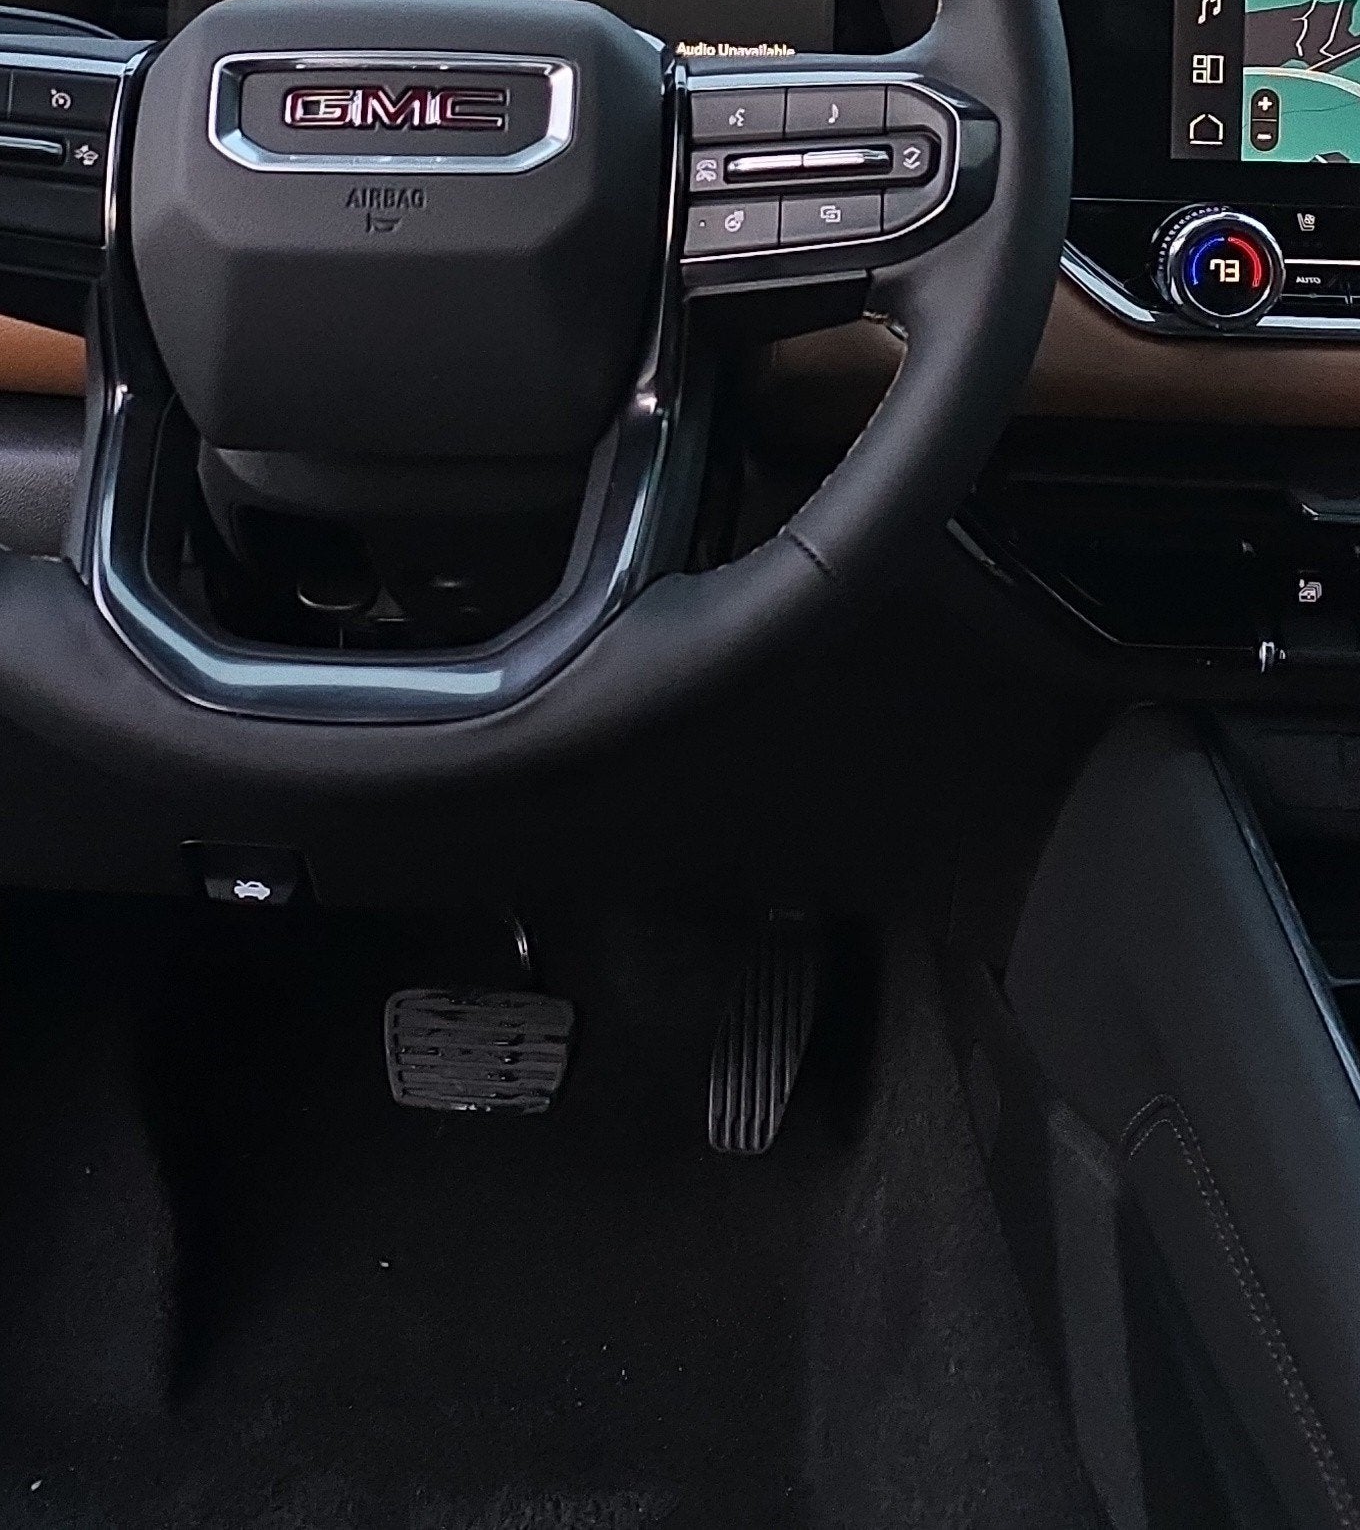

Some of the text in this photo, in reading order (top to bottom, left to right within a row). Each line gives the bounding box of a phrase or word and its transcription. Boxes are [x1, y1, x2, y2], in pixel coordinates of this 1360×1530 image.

[675, 41, 796, 57] Audio Unavailable
[285, 87, 509, 131] GMC
[344, 186, 427, 209] AIRBAG
[1209, 258, 1240, 283] 73
[1295, 275, 1322, 285] AUTO
